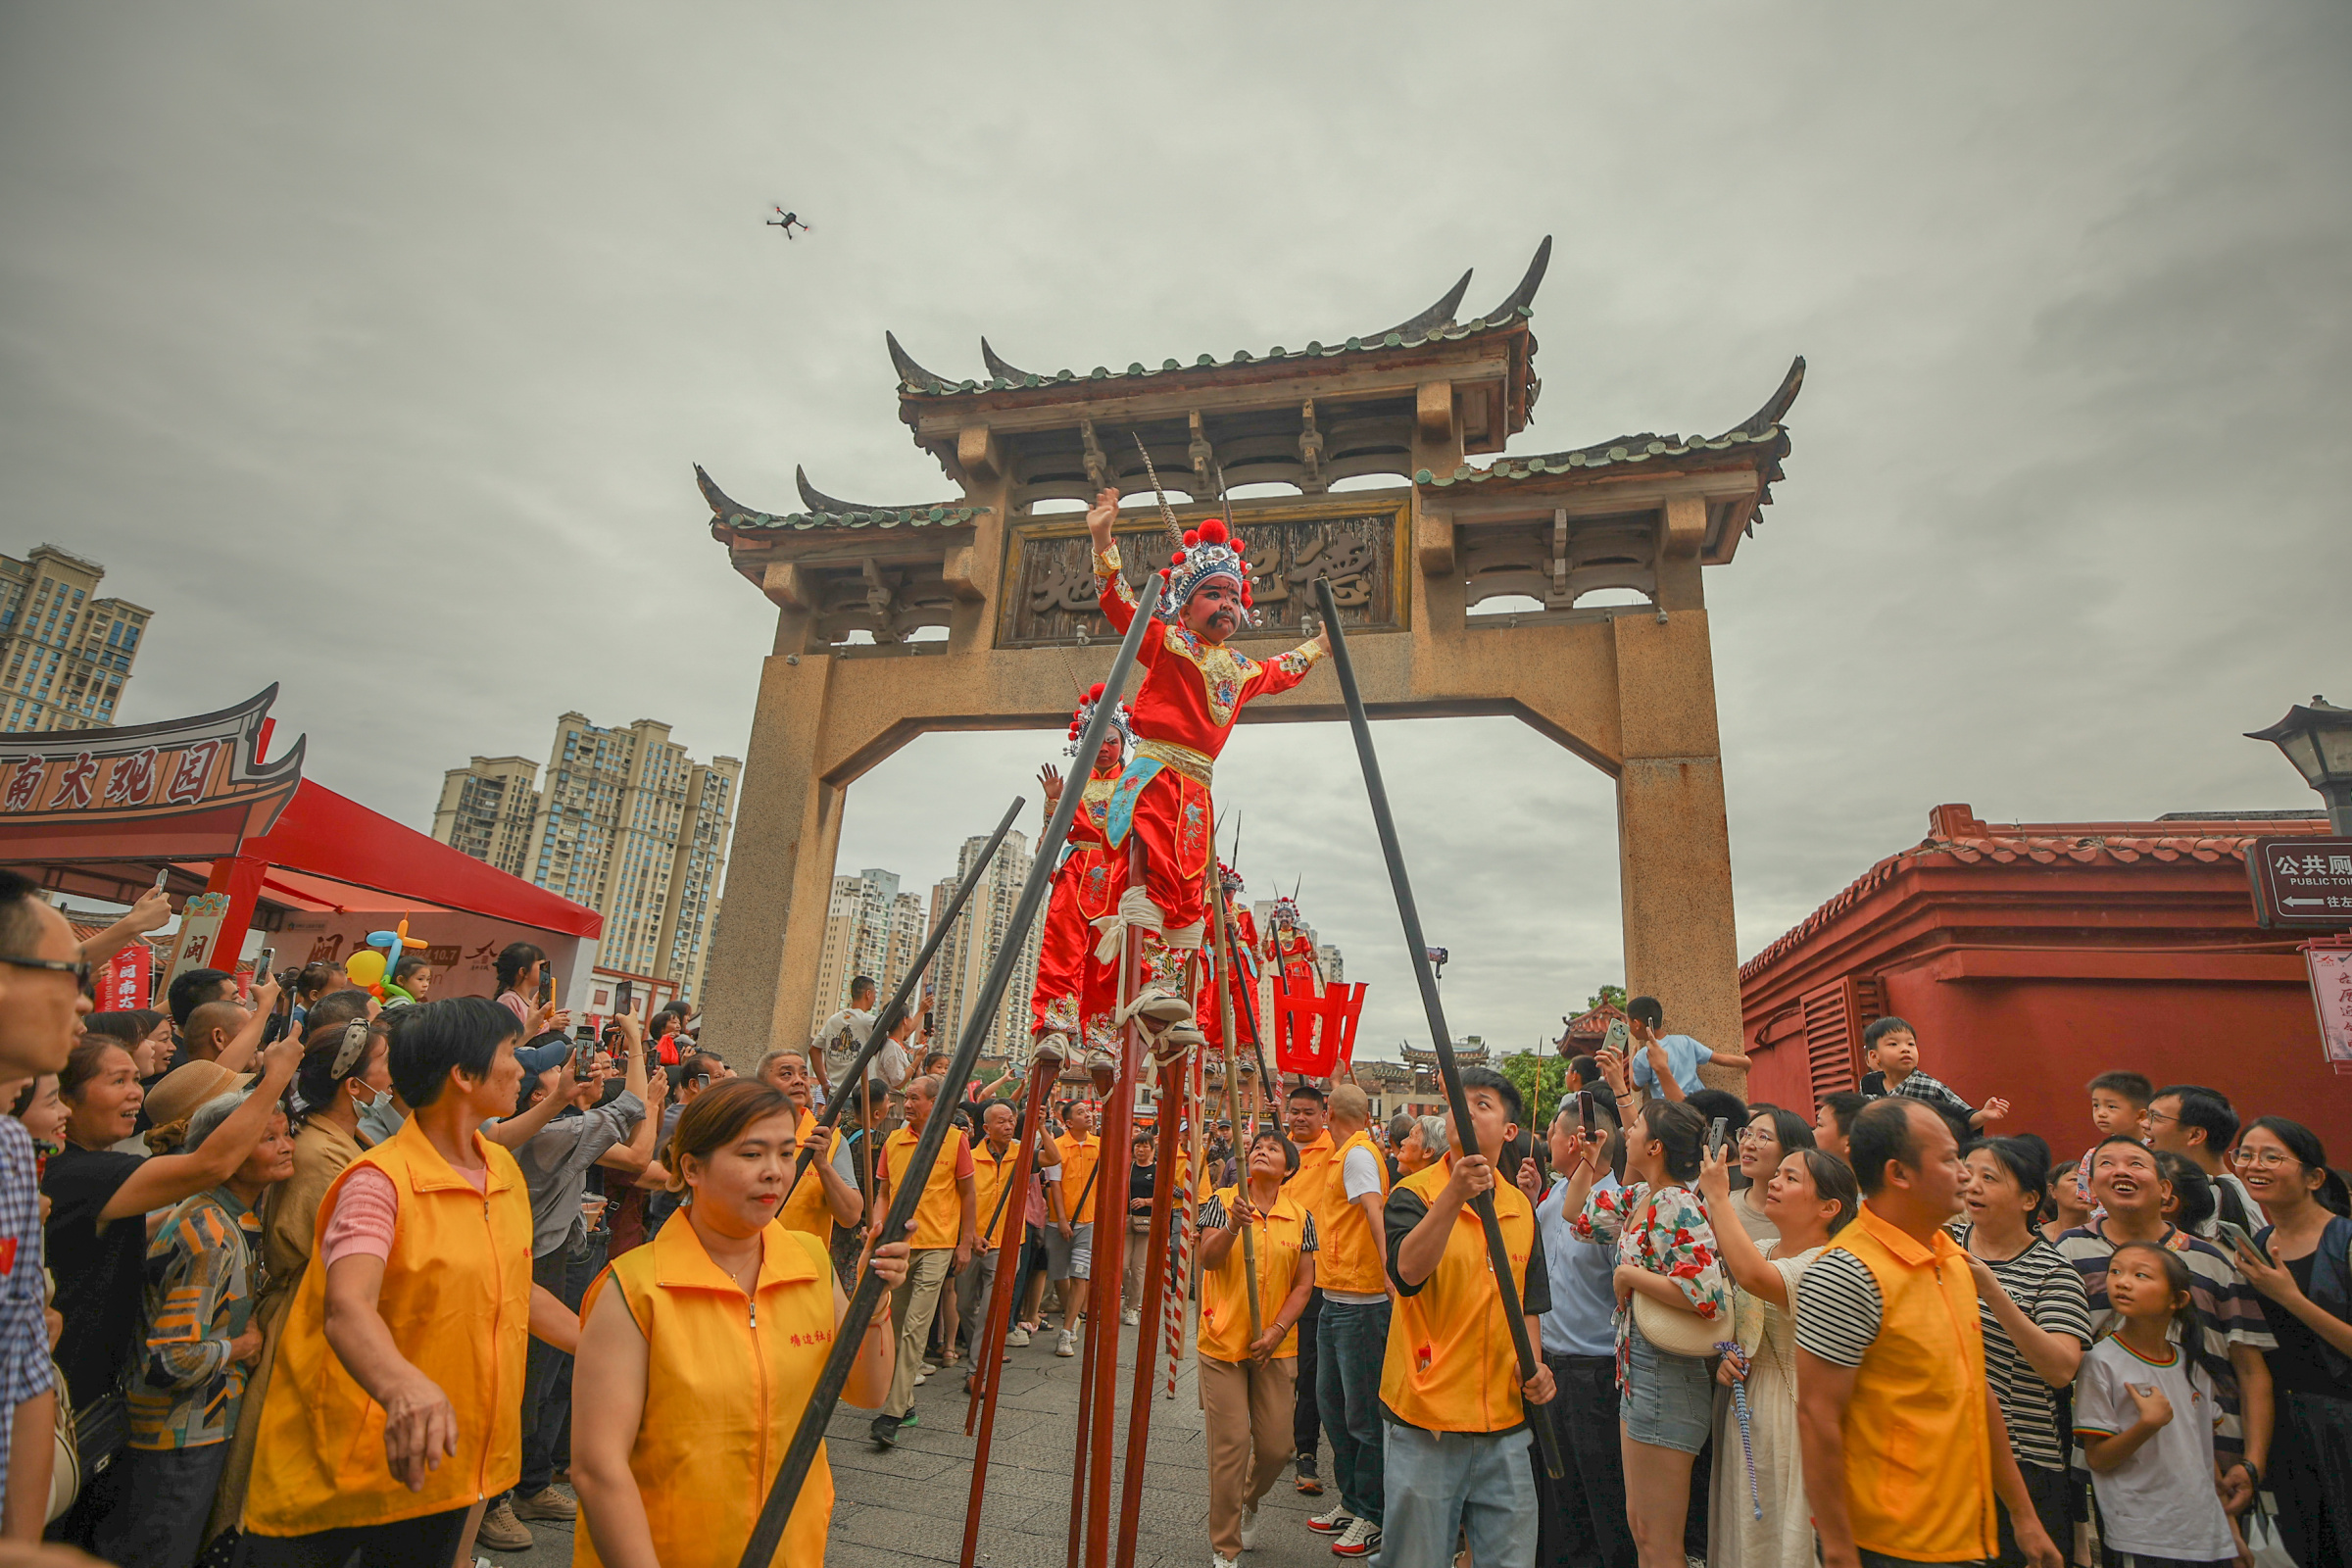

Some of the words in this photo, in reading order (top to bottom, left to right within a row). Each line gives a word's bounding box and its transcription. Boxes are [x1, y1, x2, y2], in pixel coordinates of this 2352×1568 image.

[5, 738, 221, 810] 南大观园
[2275, 855, 2352, 875] 公共厕
[2289, 877, 2329, 886] PUBLIC
[182, 935, 209, 963] 闽
[433, 949, 458, 960] 10.7
